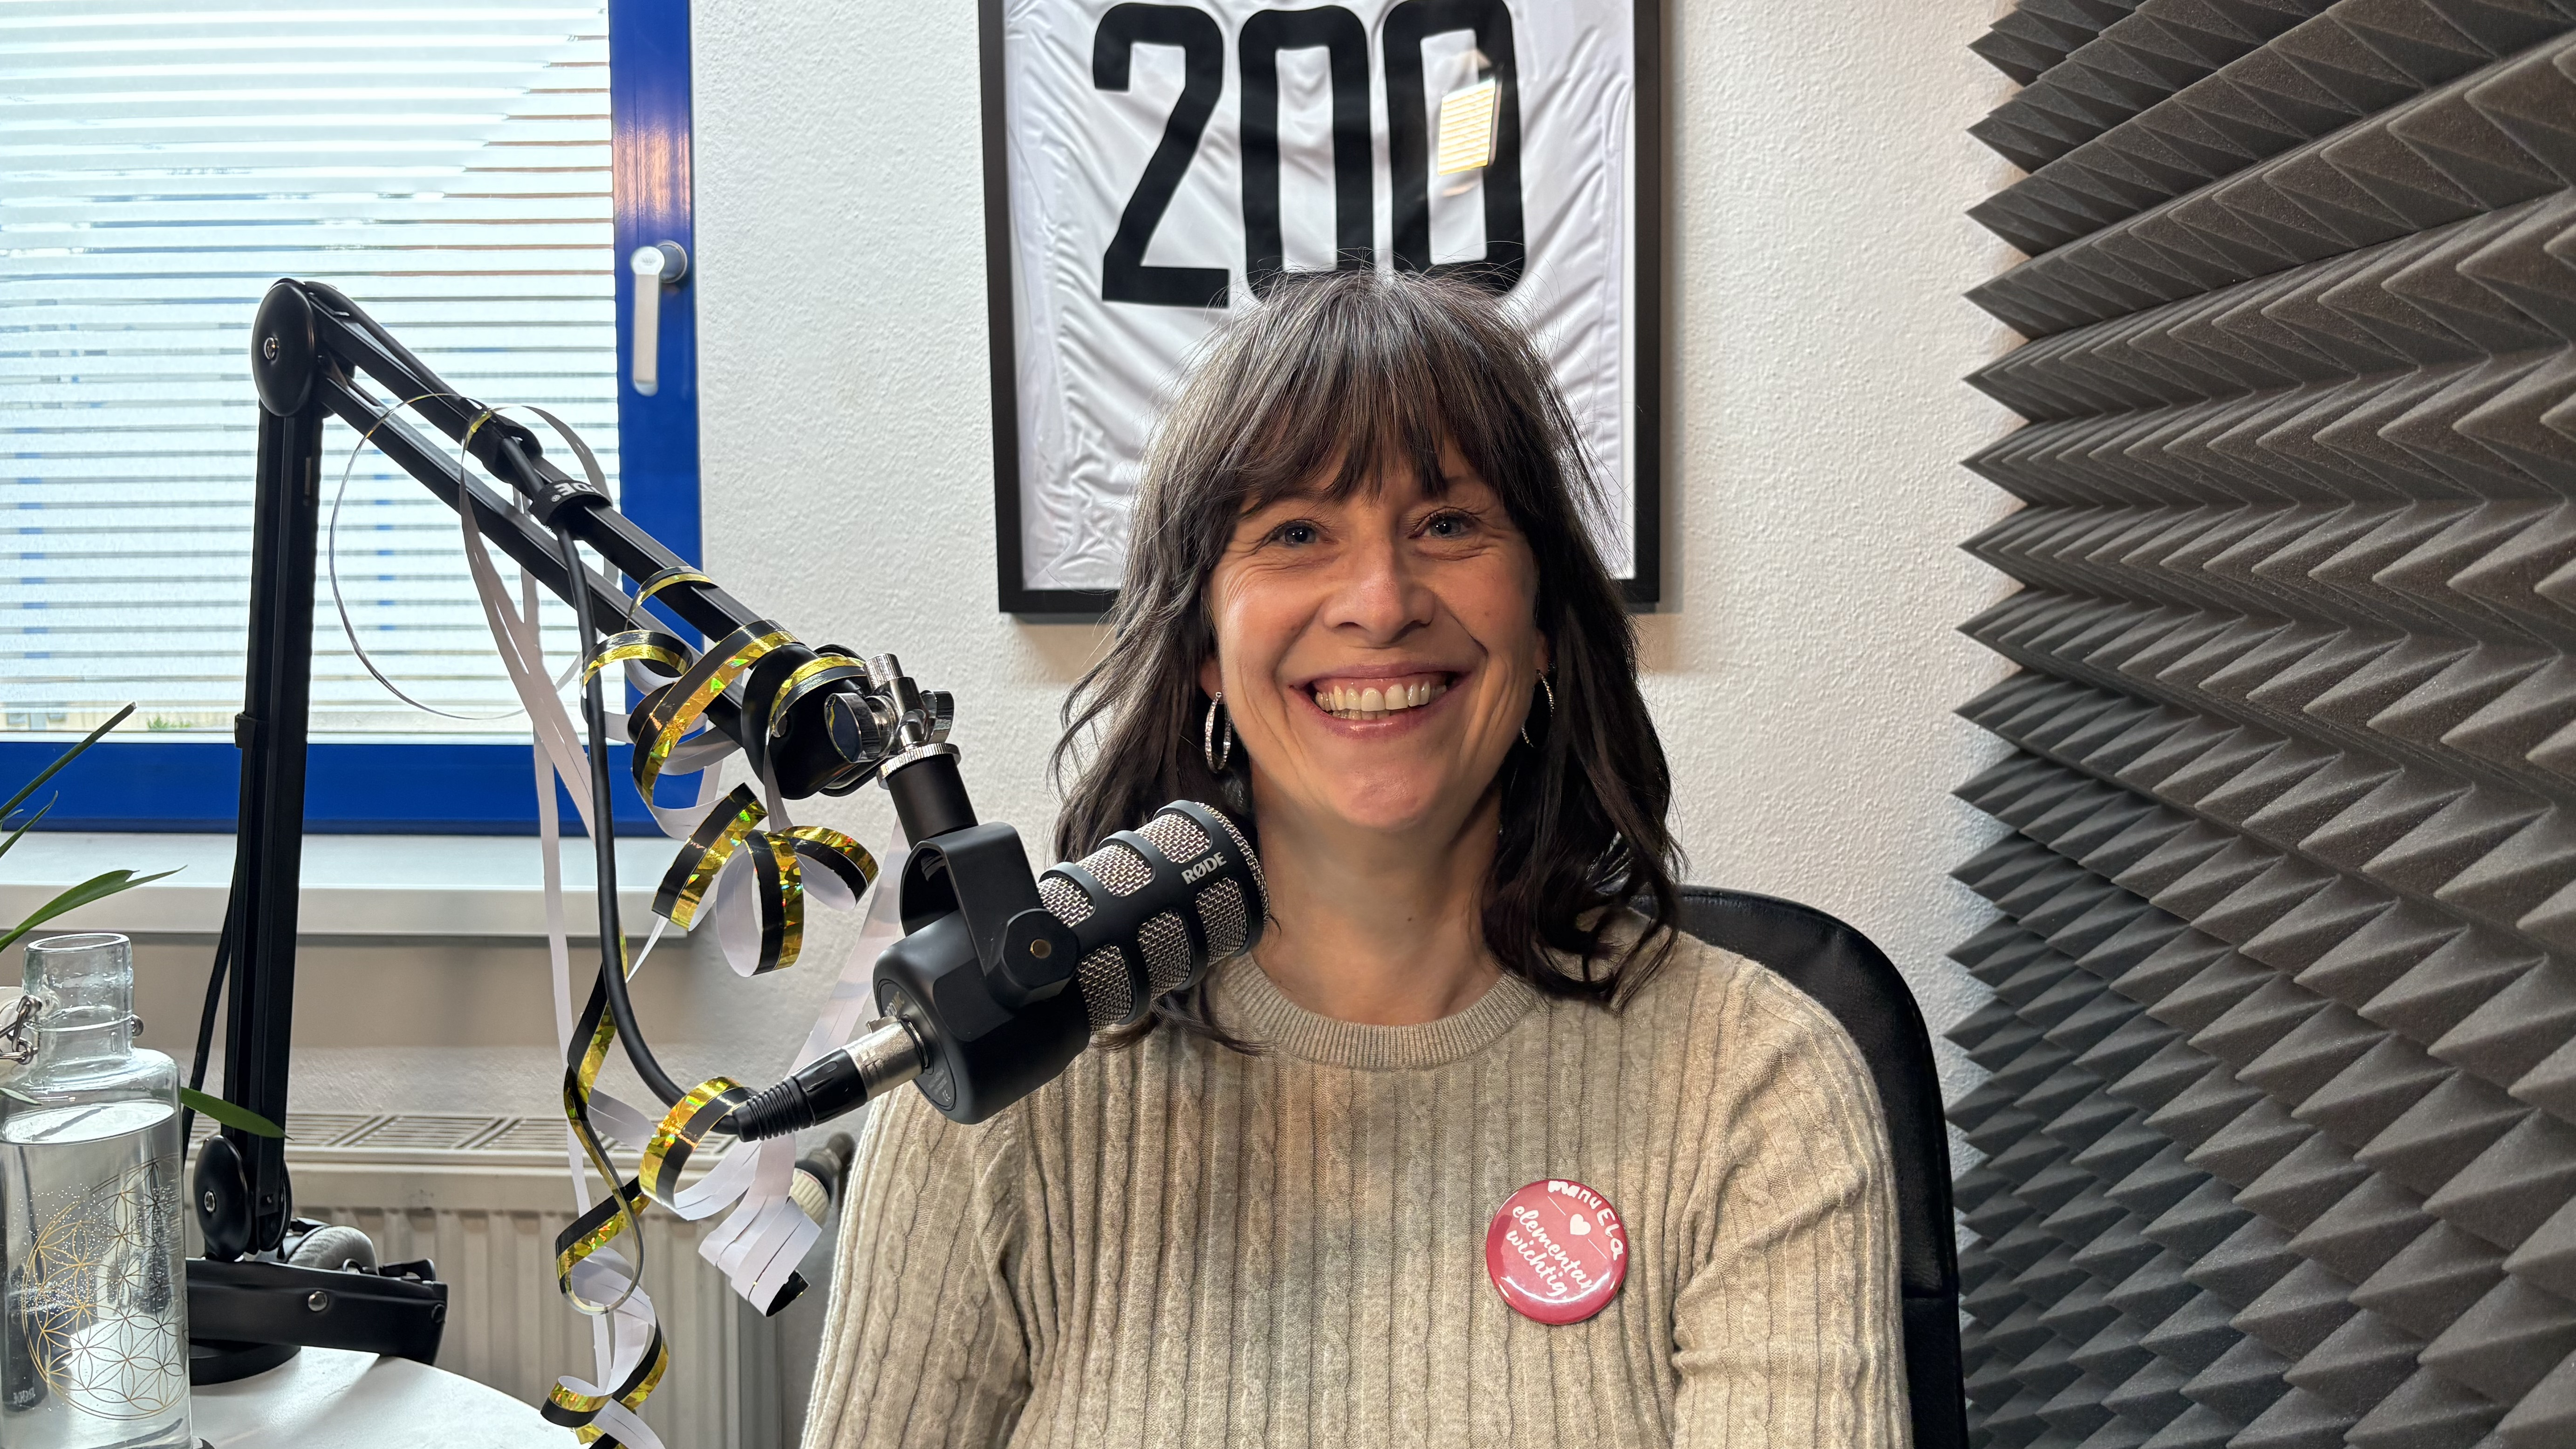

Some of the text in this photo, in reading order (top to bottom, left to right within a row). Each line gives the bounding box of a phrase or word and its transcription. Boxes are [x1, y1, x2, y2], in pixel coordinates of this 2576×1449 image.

[1093, 0, 1525, 308] 200
[1181, 852, 1227, 884] RØDE
[1512, 1206, 1593, 1289] elementar
